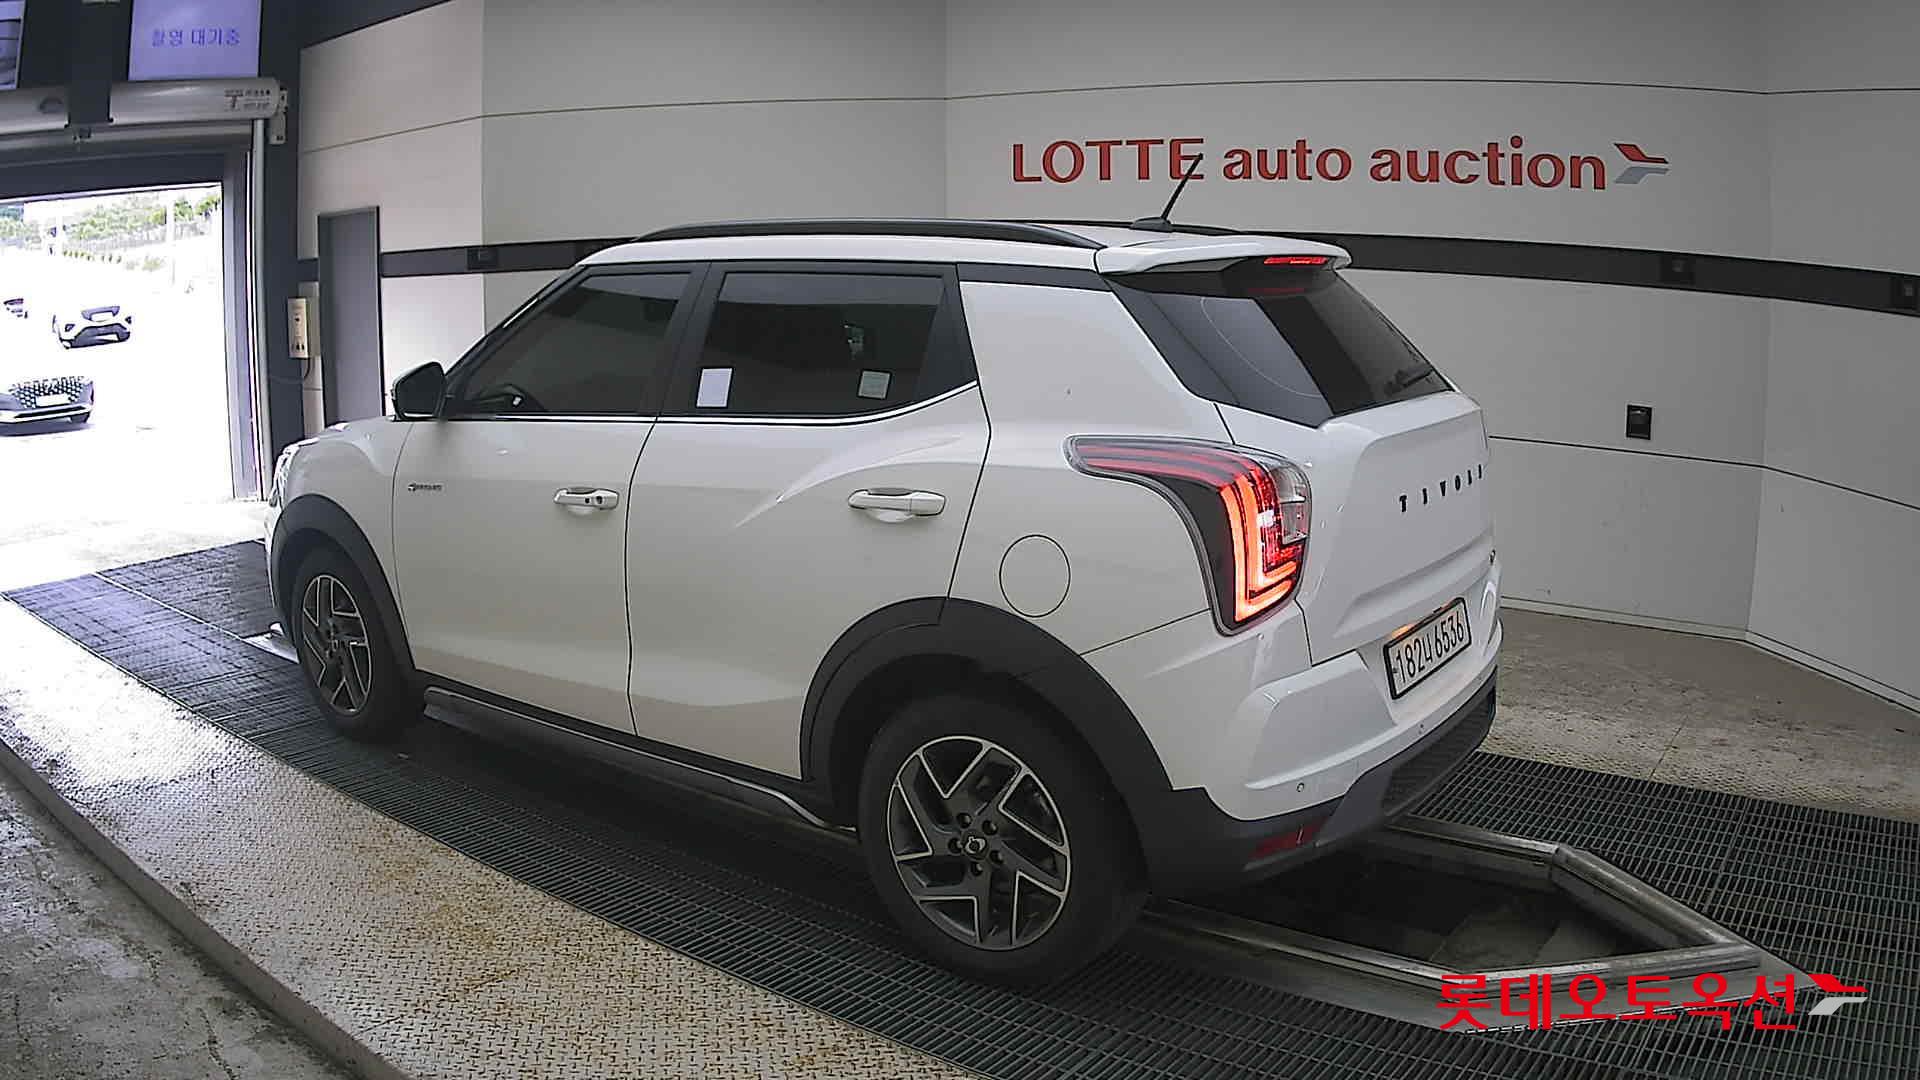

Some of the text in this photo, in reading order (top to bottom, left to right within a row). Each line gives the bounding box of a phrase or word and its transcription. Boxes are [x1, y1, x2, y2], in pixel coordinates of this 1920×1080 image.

[1012, 135, 1606, 190] LOTTE auto auction
[1434, 611, 1464, 658] 6536
